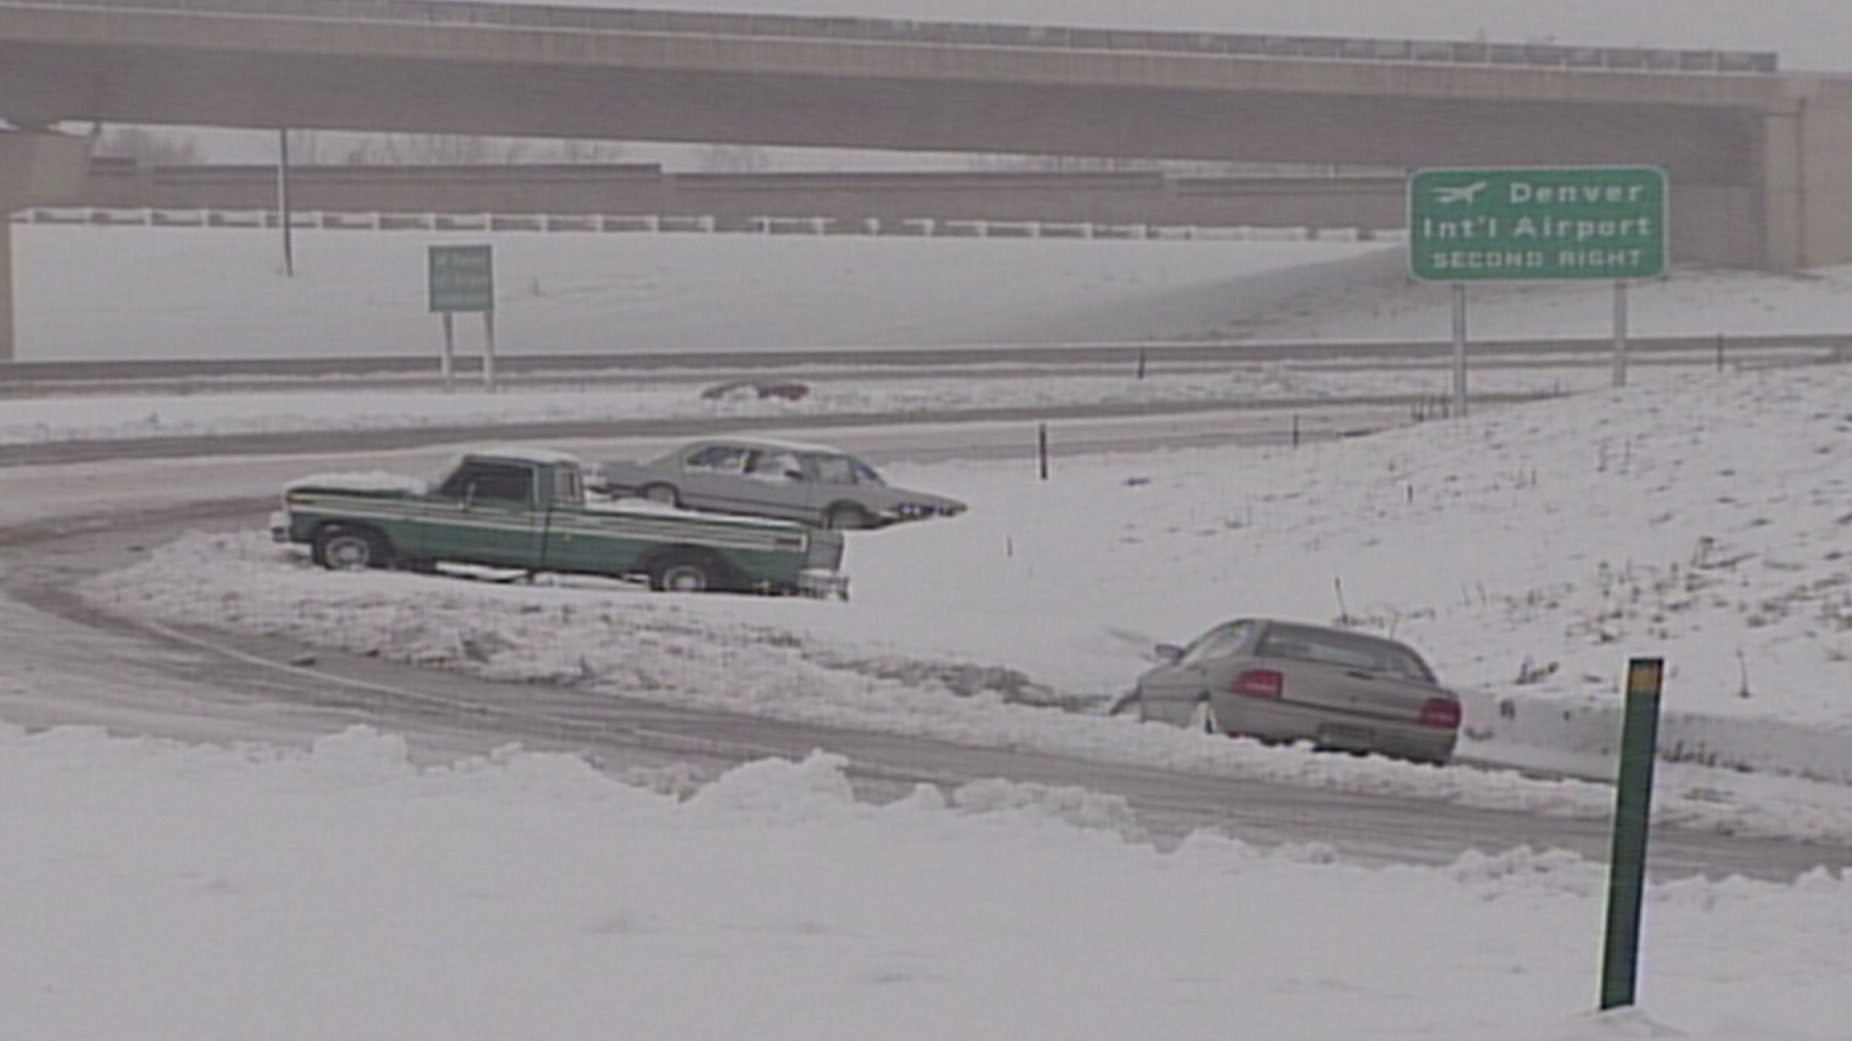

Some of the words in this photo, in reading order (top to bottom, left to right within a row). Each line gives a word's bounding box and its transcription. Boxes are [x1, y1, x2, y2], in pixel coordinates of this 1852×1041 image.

[1510, 182, 1644, 204] Denver
[1424, 217, 1496, 239] Int'l
[1514, 216, 1650, 241] Airport
[1433, 251, 1544, 269] SECOND
[1559, 249, 1642, 267] RIGHT
